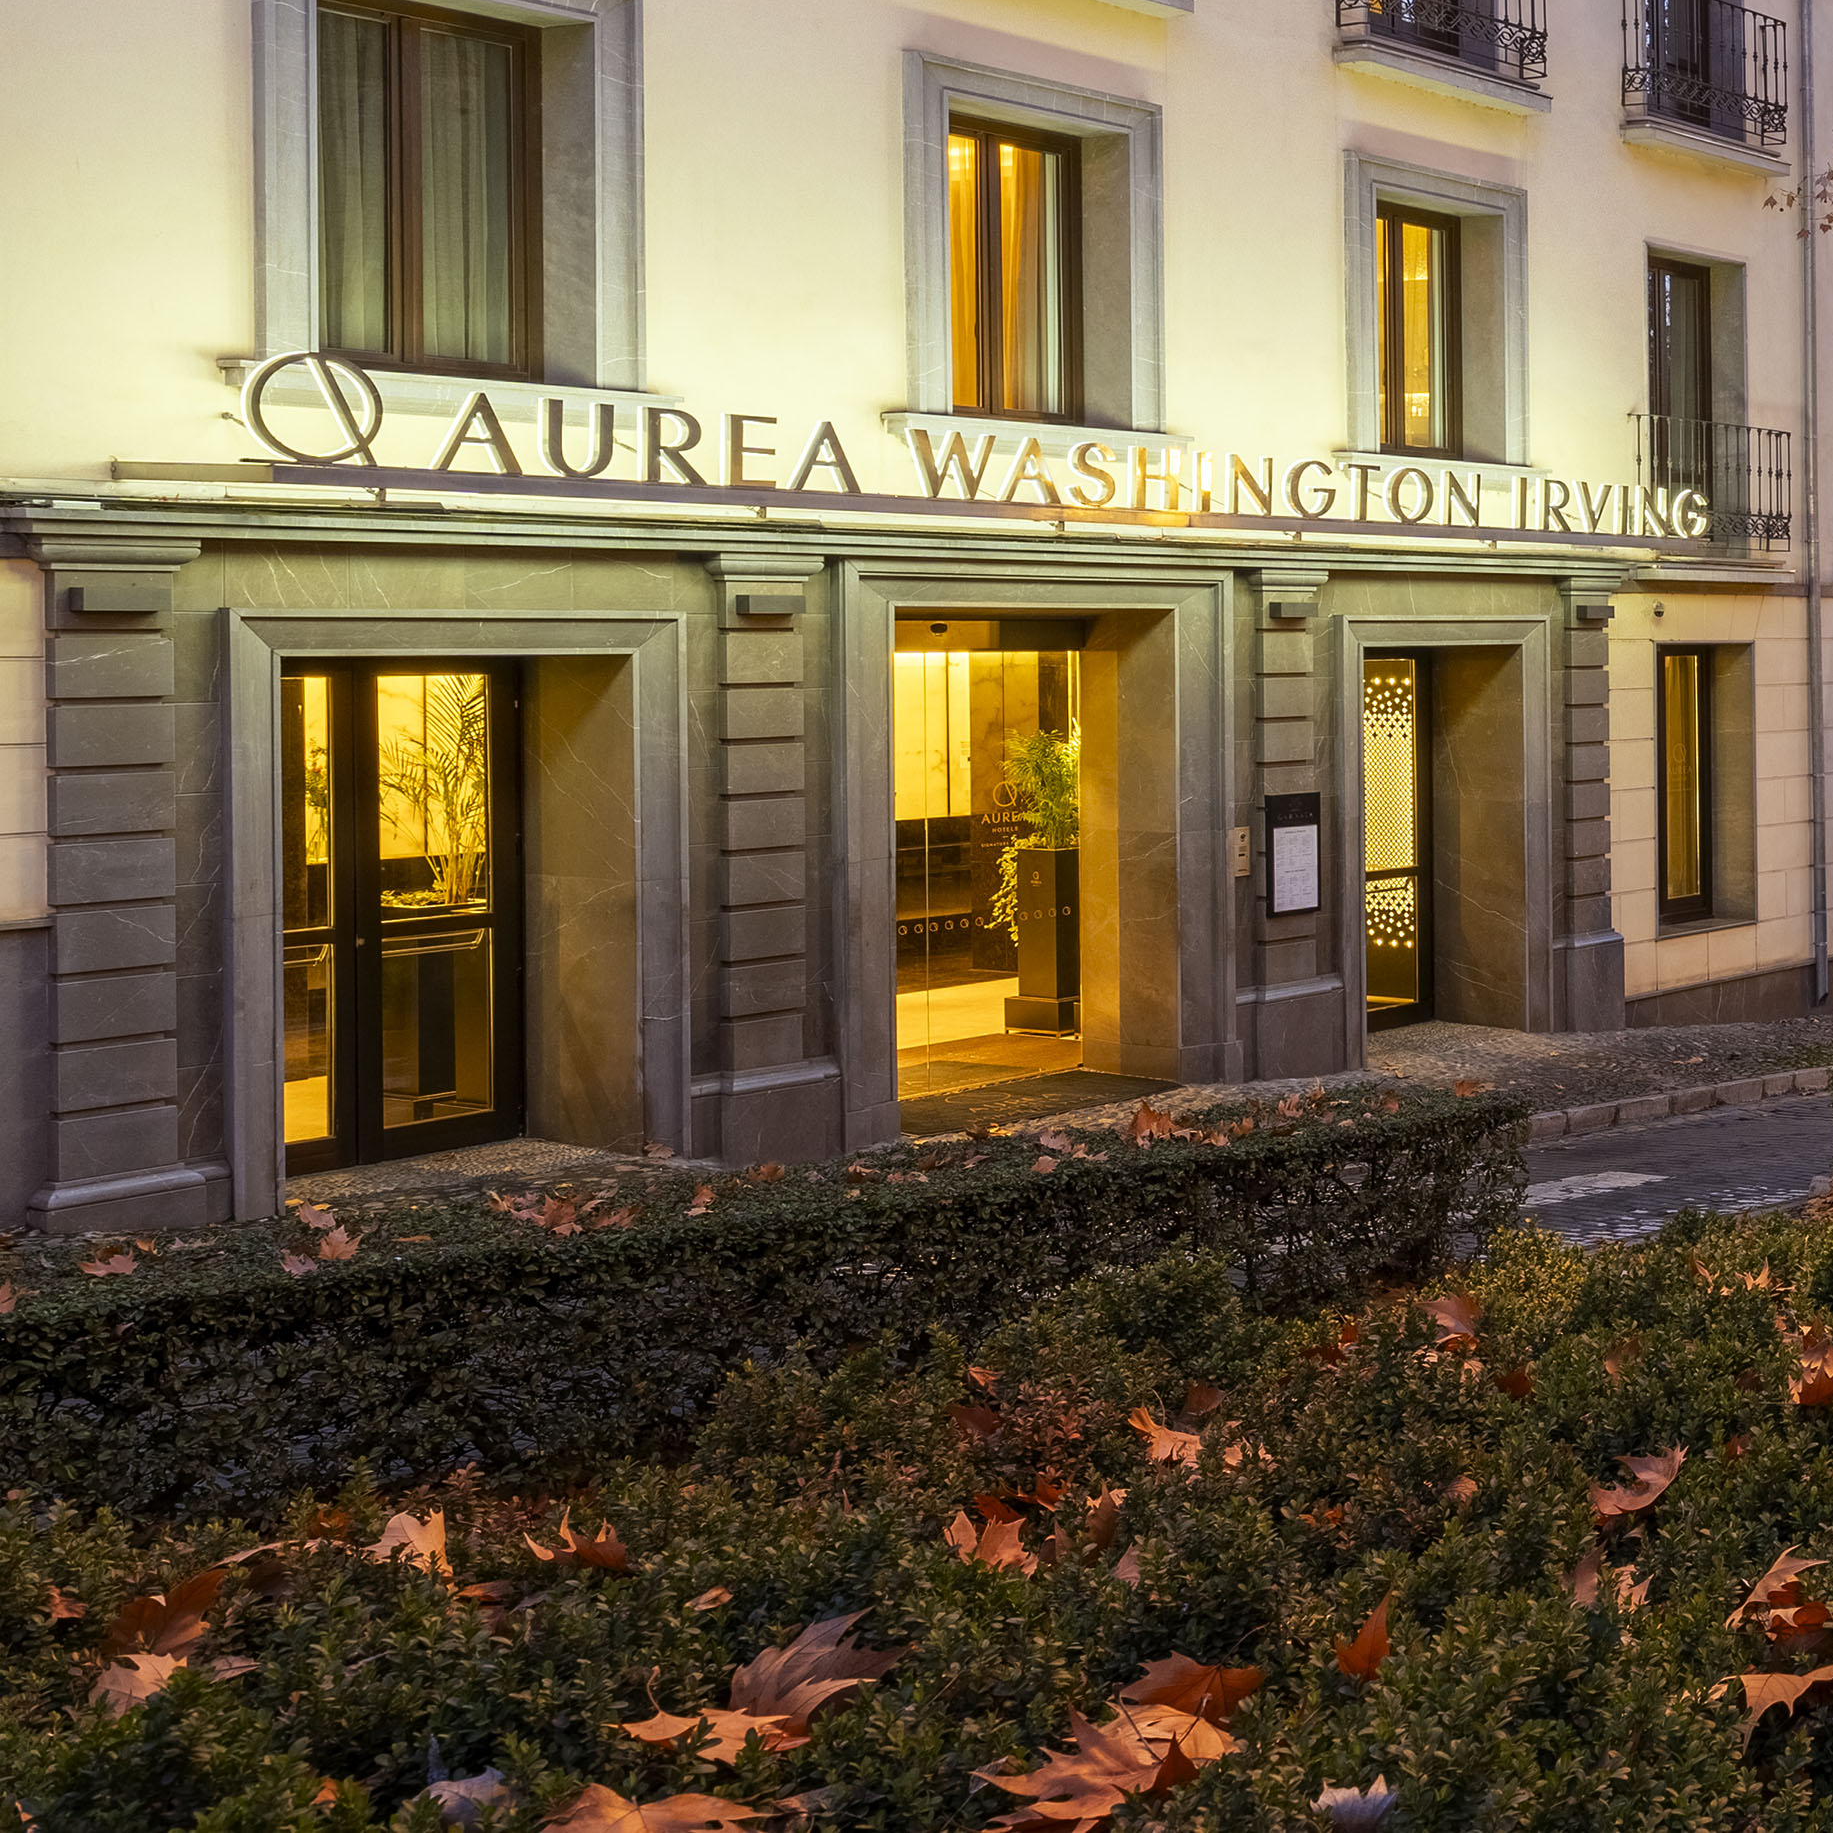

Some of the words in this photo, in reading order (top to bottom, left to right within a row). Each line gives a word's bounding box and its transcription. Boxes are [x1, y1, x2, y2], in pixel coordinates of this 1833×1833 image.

[429, 392, 861, 494] AUREA
[904, 428, 1480, 527] WASHINGTON
[1511, 476, 1709, 538] IRVING
